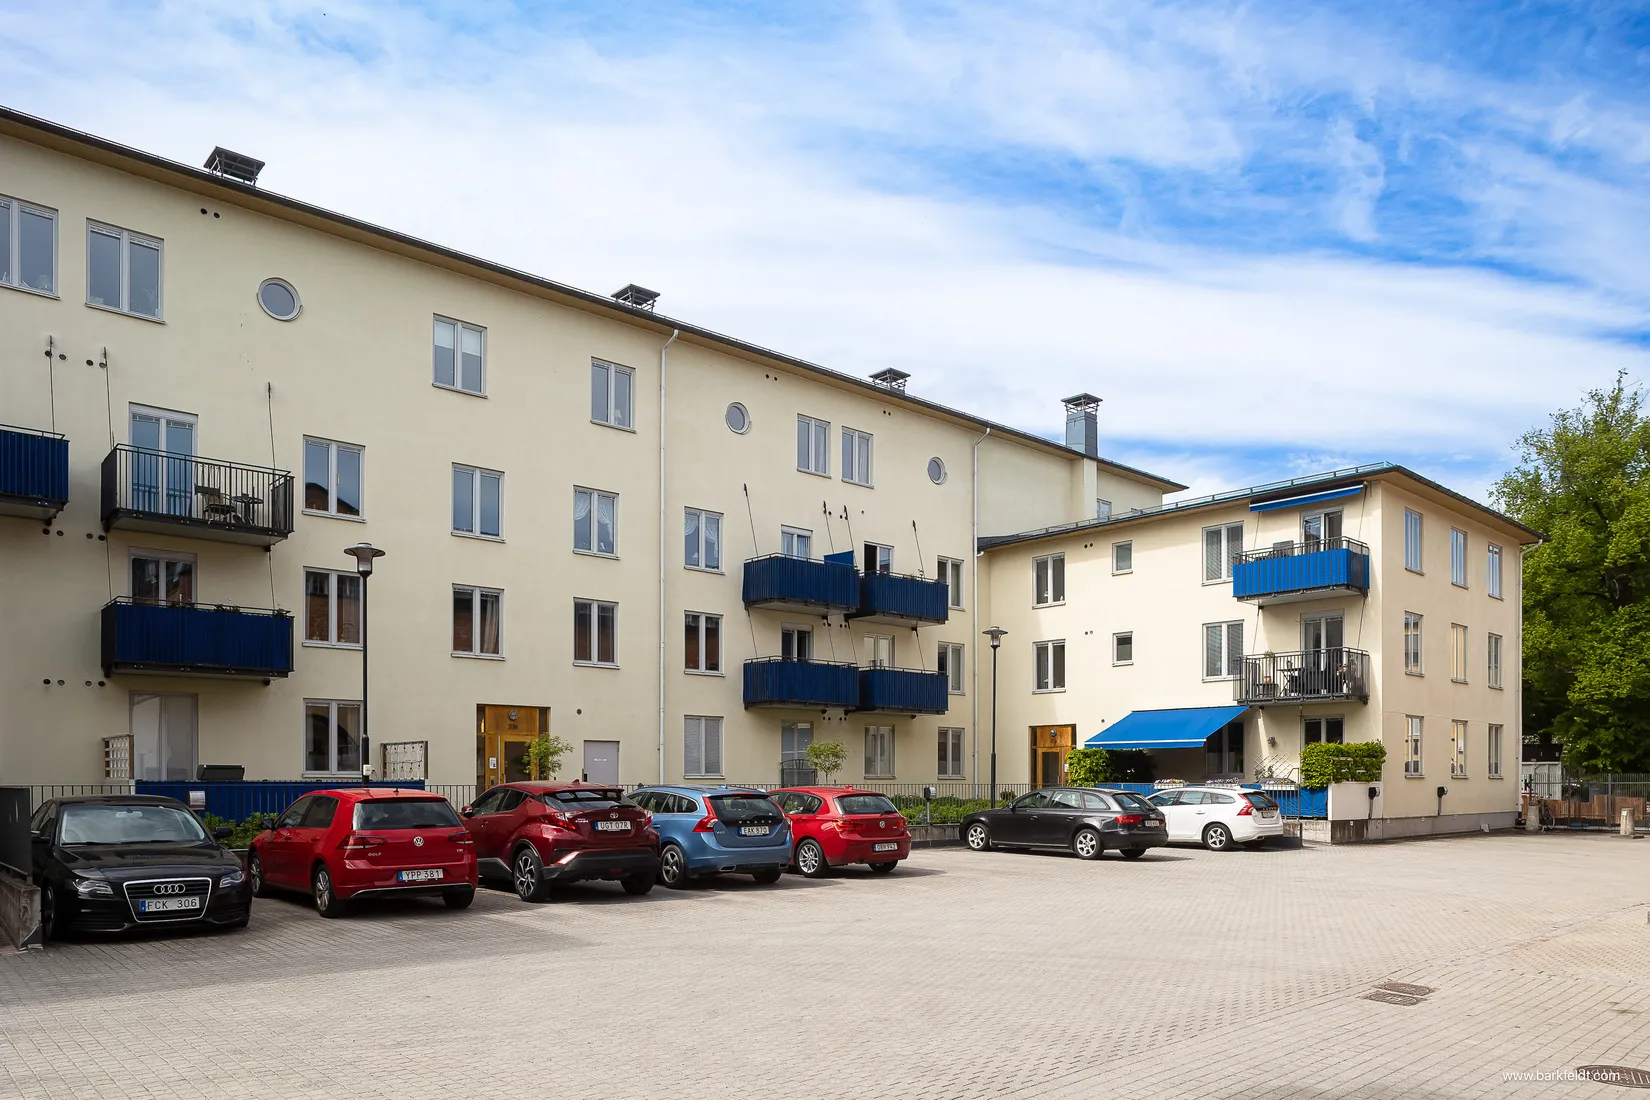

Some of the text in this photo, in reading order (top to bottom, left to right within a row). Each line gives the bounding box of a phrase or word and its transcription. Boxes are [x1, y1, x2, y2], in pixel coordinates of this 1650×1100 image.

[600, 821, 613, 829] UGT
[405, 869, 440, 880] YPP 381
[147, 899, 197, 910] FCK 306
